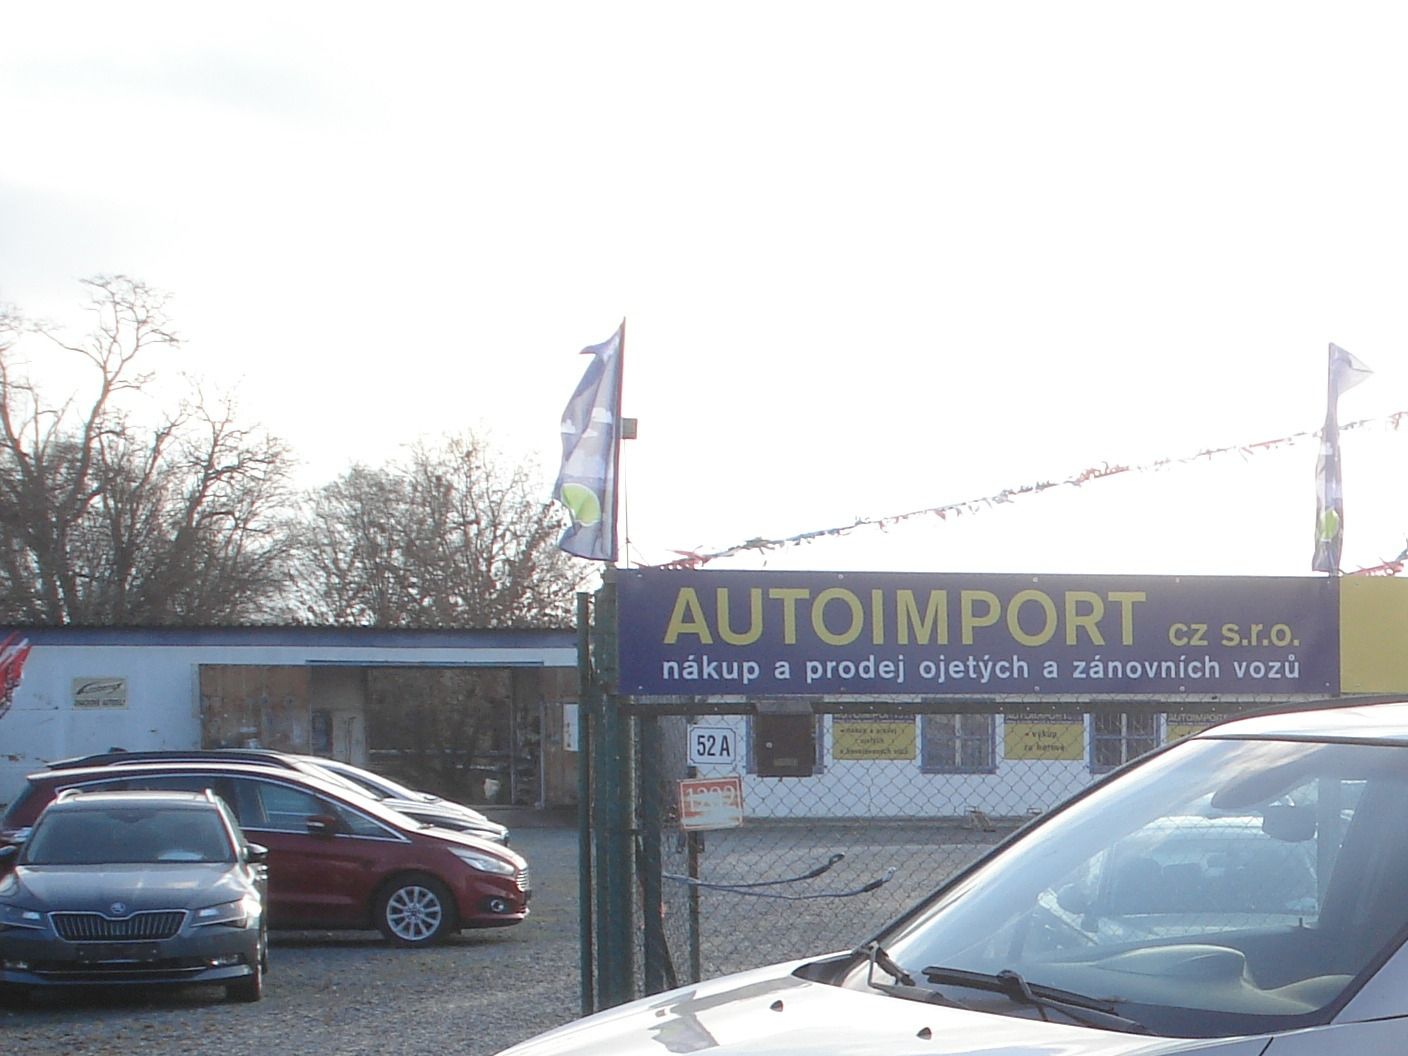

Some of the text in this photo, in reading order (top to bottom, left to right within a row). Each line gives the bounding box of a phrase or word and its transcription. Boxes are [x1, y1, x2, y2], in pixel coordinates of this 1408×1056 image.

[662, 586, 1147, 647] AUTOIMPORT
[1221, 622, 1300, 647] s.r.o.
[663, 653, 1300, 684] nákup a prodej ojetých a zánovních vozů
